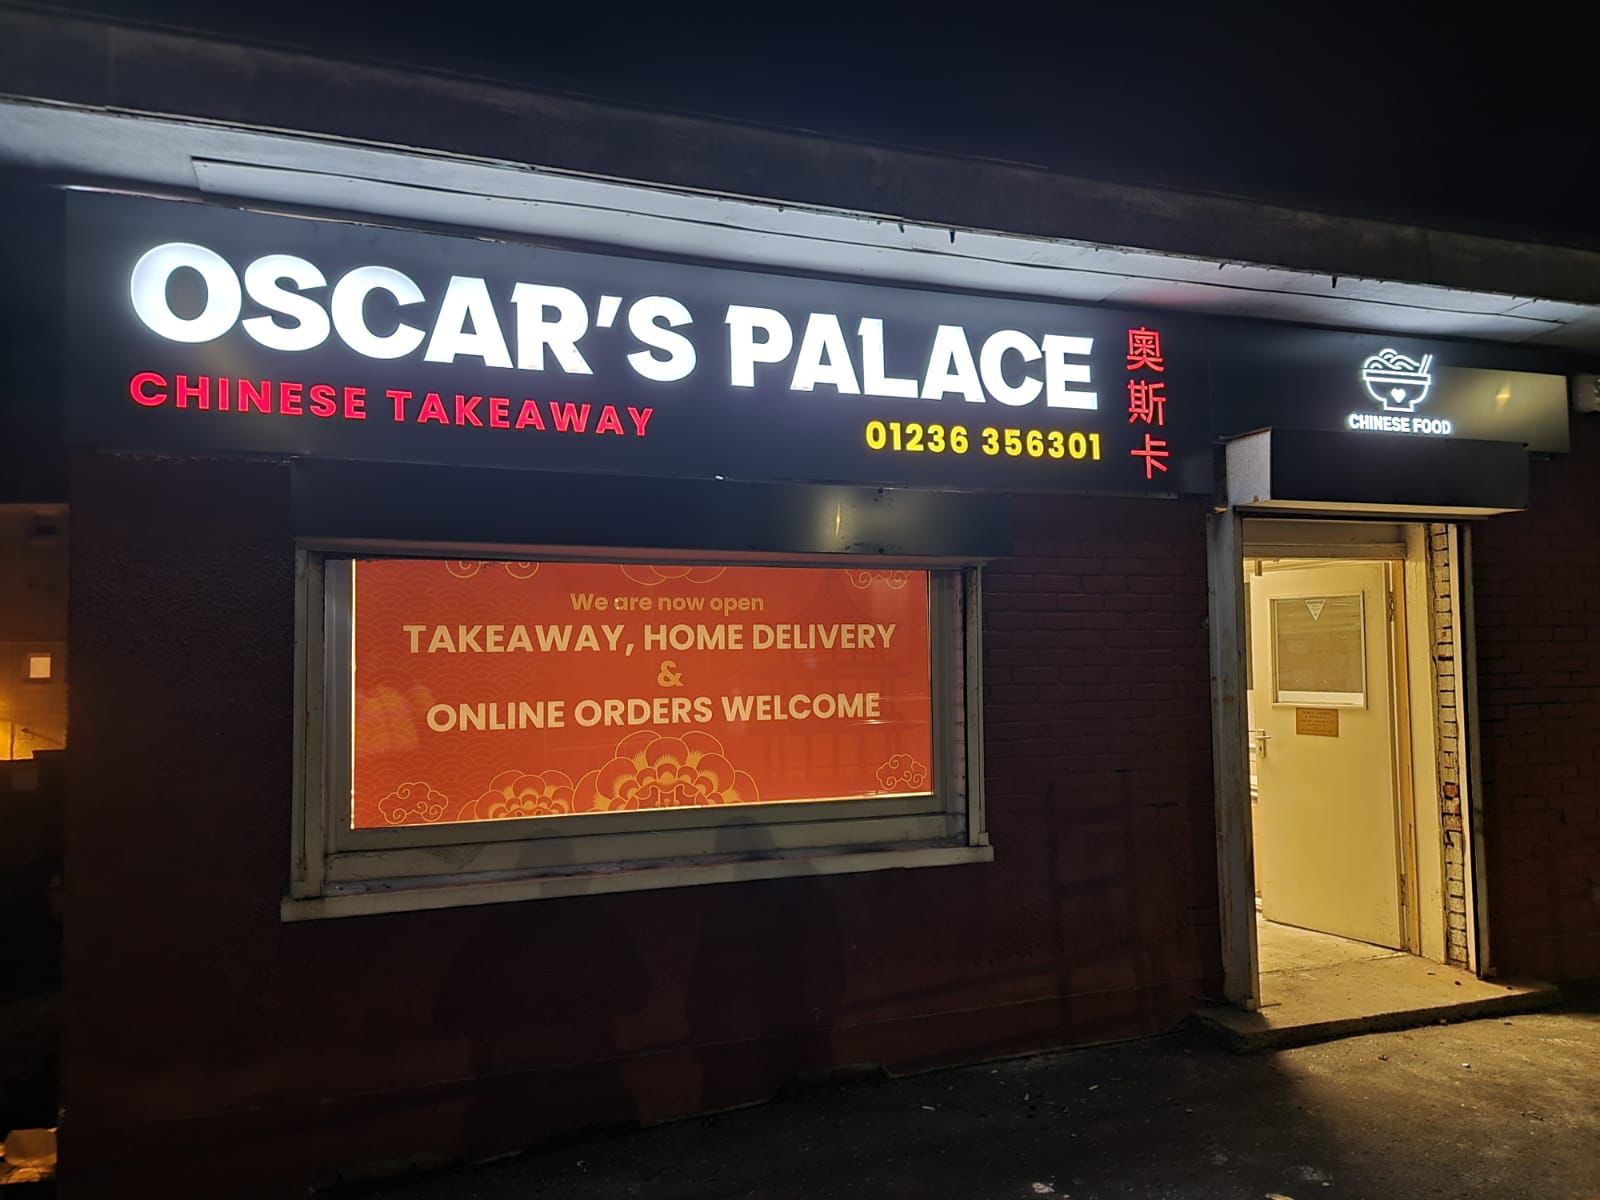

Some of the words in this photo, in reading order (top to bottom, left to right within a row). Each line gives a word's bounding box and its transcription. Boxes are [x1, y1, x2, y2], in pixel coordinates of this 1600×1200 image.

[130, 241, 697, 383] OSCAR'S
[724, 304, 1098, 410] PALACE
[129, 371, 367, 420] CHINESE
[386, 389, 654, 437] TAKEAWAY
[1126, 326, 1169, 480] 奥斯卡
[865, 420, 969, 454] 01236
[982, 427, 1102, 461] 356301
[1349, 414, 1410, 432] CHINESE
[1413, 418, 1451, 434] FOOD
[571, 593, 608, 611] We
[614, 596, 652, 612] are
[658, 596, 704, 612] now
[710, 596, 764, 616] open
[403, 624, 633, 656] TAKEAWAY,
[644, 623, 744, 651] HOME
[752, 623, 896, 649] DELIVERY
[657, 660, 684, 687] &
[426, 700, 565, 732] ONLINE
[574, 696, 713, 728] ORDERS
[721, 692, 881, 723] WELCOME
